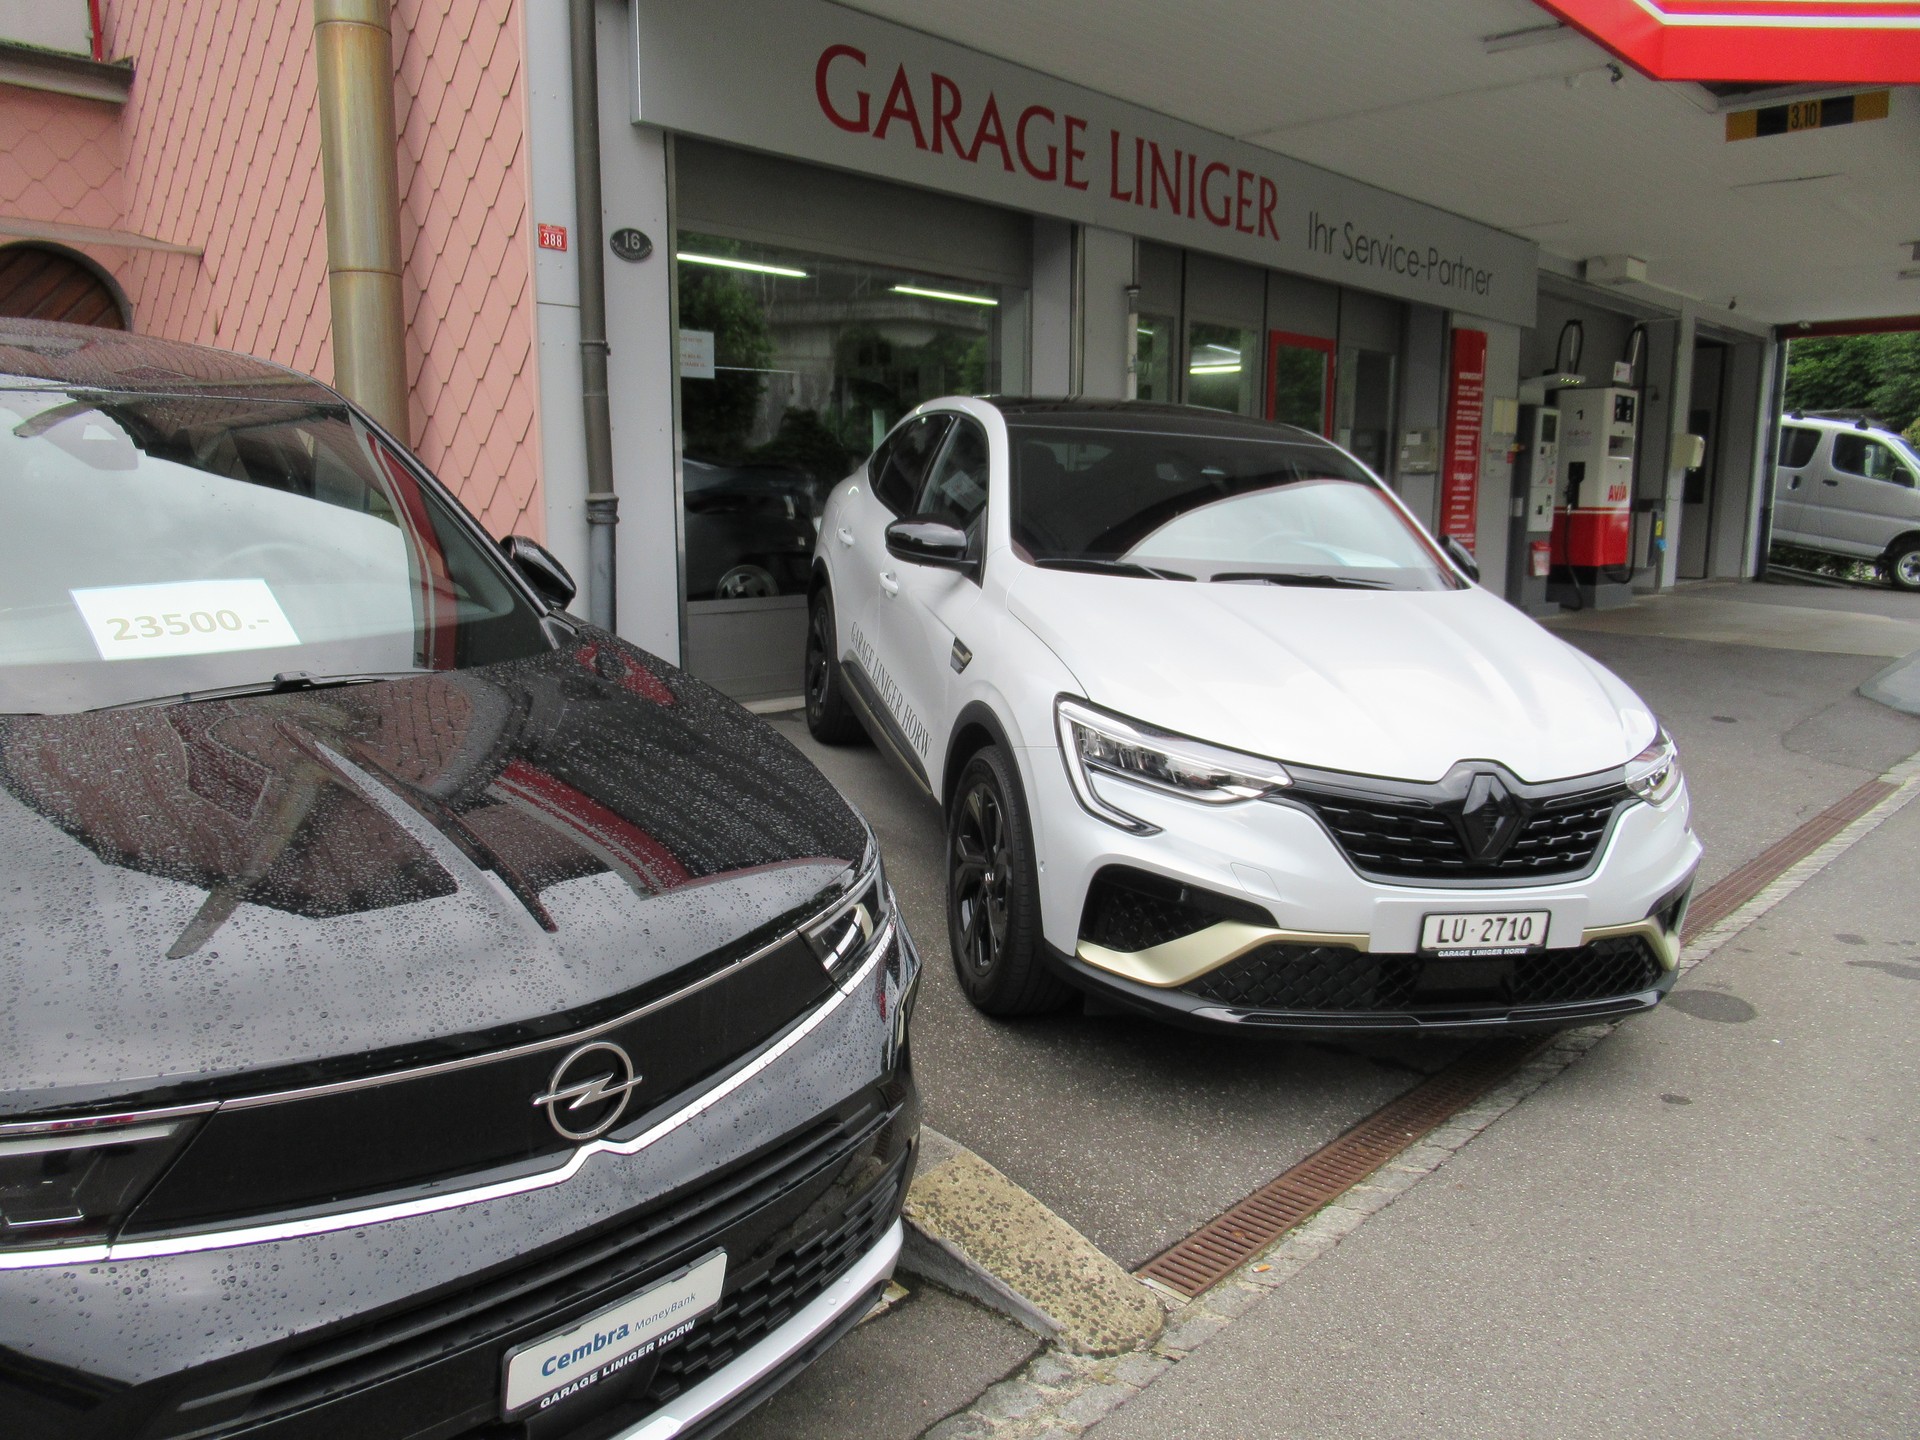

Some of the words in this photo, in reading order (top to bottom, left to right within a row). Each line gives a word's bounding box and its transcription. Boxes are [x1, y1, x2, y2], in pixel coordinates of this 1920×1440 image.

[1791, 102, 1818, 130] 3.10
[815, 43, 1090, 191] GARAGE
[1110, 129, 1281, 242] LINIGER
[543, 232, 562, 248] 388
[623, 231, 640, 250] 16
[1308, 211, 1337, 255] Ihr
[1342, 221, 1493, 297] Service-Partner
[106, 608, 270, 642] 23500.-
[850, 621, 875, 672] GARAGE
[872, 658, 904, 720] LINIGER
[902, 704, 933, 760] HORW
[1436, 918, 1467, 944] LU
[1480, 916, 1533, 942] 2710
[1472, 949, 1502, 957] LINIGER
[541, 1323, 630, 1377] Cembra
[634, 1292, 697, 1332] MoneyBank
[540, 1373, 599, 1409] GARAGE
[602, 1342, 655, 1377] LINIGER
[658, 1318, 696, 1347] HORW
